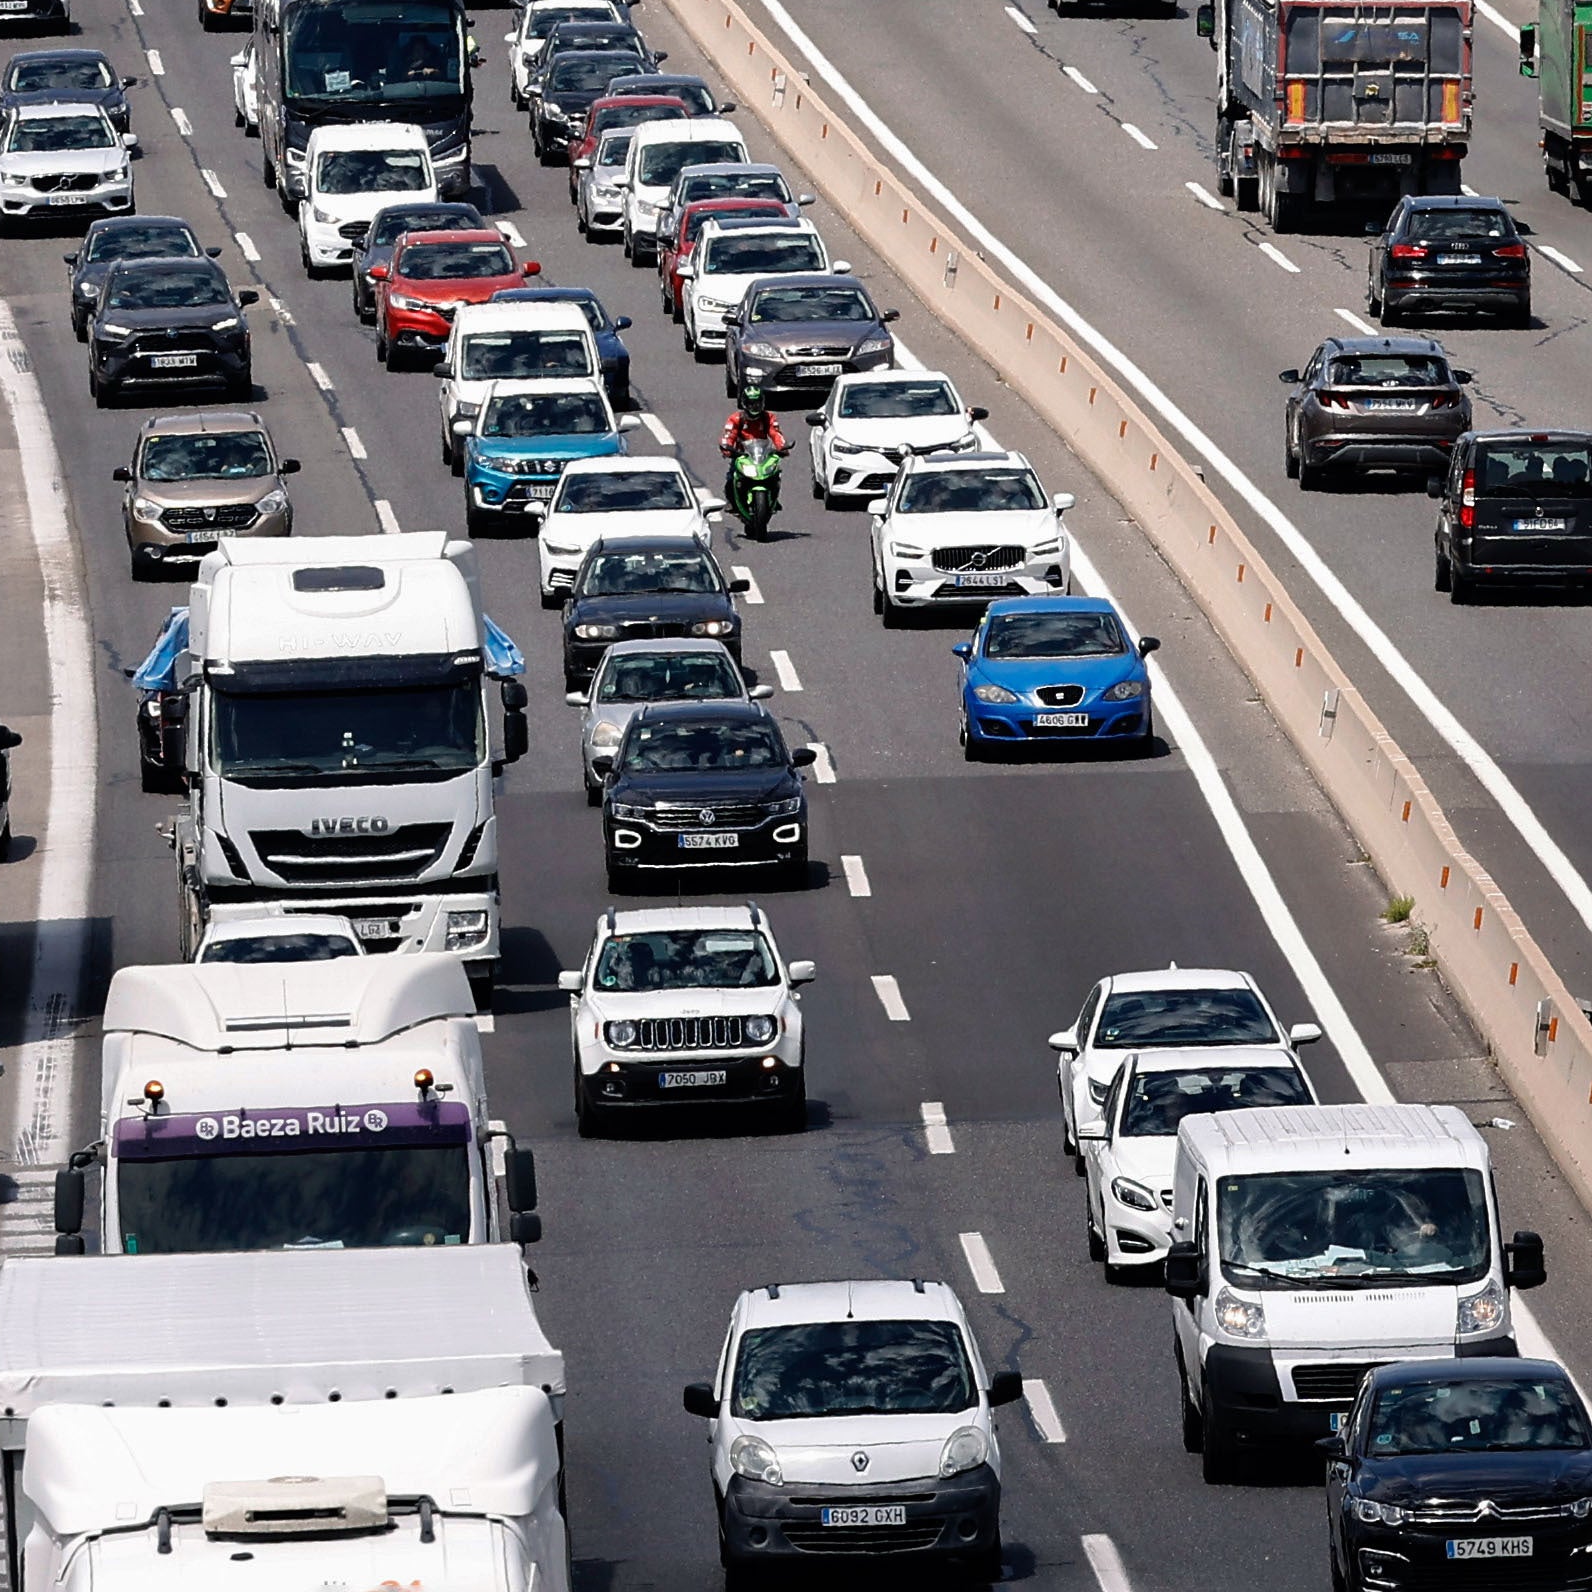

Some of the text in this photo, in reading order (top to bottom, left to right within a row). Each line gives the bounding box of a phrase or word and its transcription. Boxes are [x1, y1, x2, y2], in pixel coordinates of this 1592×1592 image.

[311, 815, 389, 835] IVECO
[667, 1072, 725, 1085] 7050 JBX
[222, 1115, 301, 1139] Baeza
[307, 1110, 361, 1134] Ruiz
[830, 1508, 904, 1523] 6092 GXH
[1457, 1539, 1530, 1556] 5749 KHS
